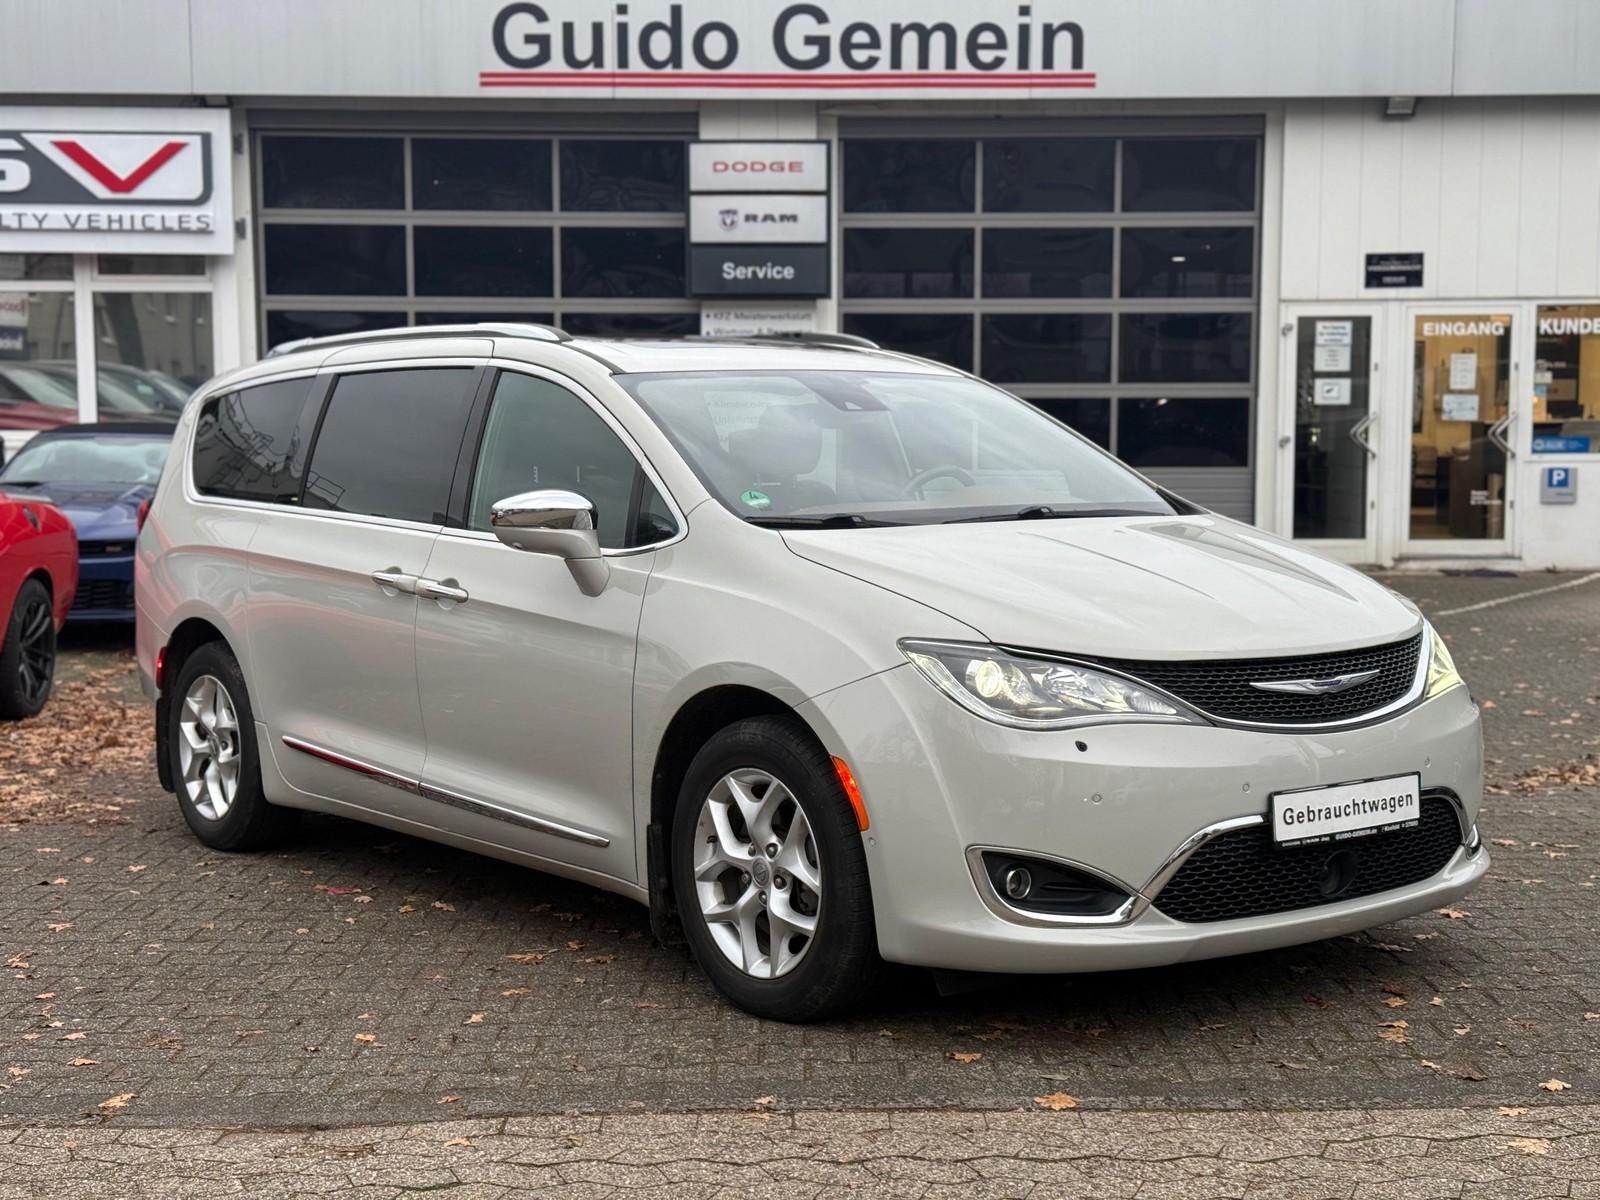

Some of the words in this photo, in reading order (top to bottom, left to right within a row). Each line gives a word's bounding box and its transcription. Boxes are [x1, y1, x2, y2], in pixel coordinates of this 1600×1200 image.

[492, 2, 739, 70] Guido
[772, 2, 1085, 70] Gemein
[712, 161, 804, 173] DODGE
[64, 213, 211, 231] VEHICLES
[744, 213, 798, 223] RAM
[722, 262, 795, 280] Service
[1423, 321, 1505, 336] EINGANG
[1552, 470, 1566, 486] P
[1283, 793, 1413, 825] Gebrauchtwagen
